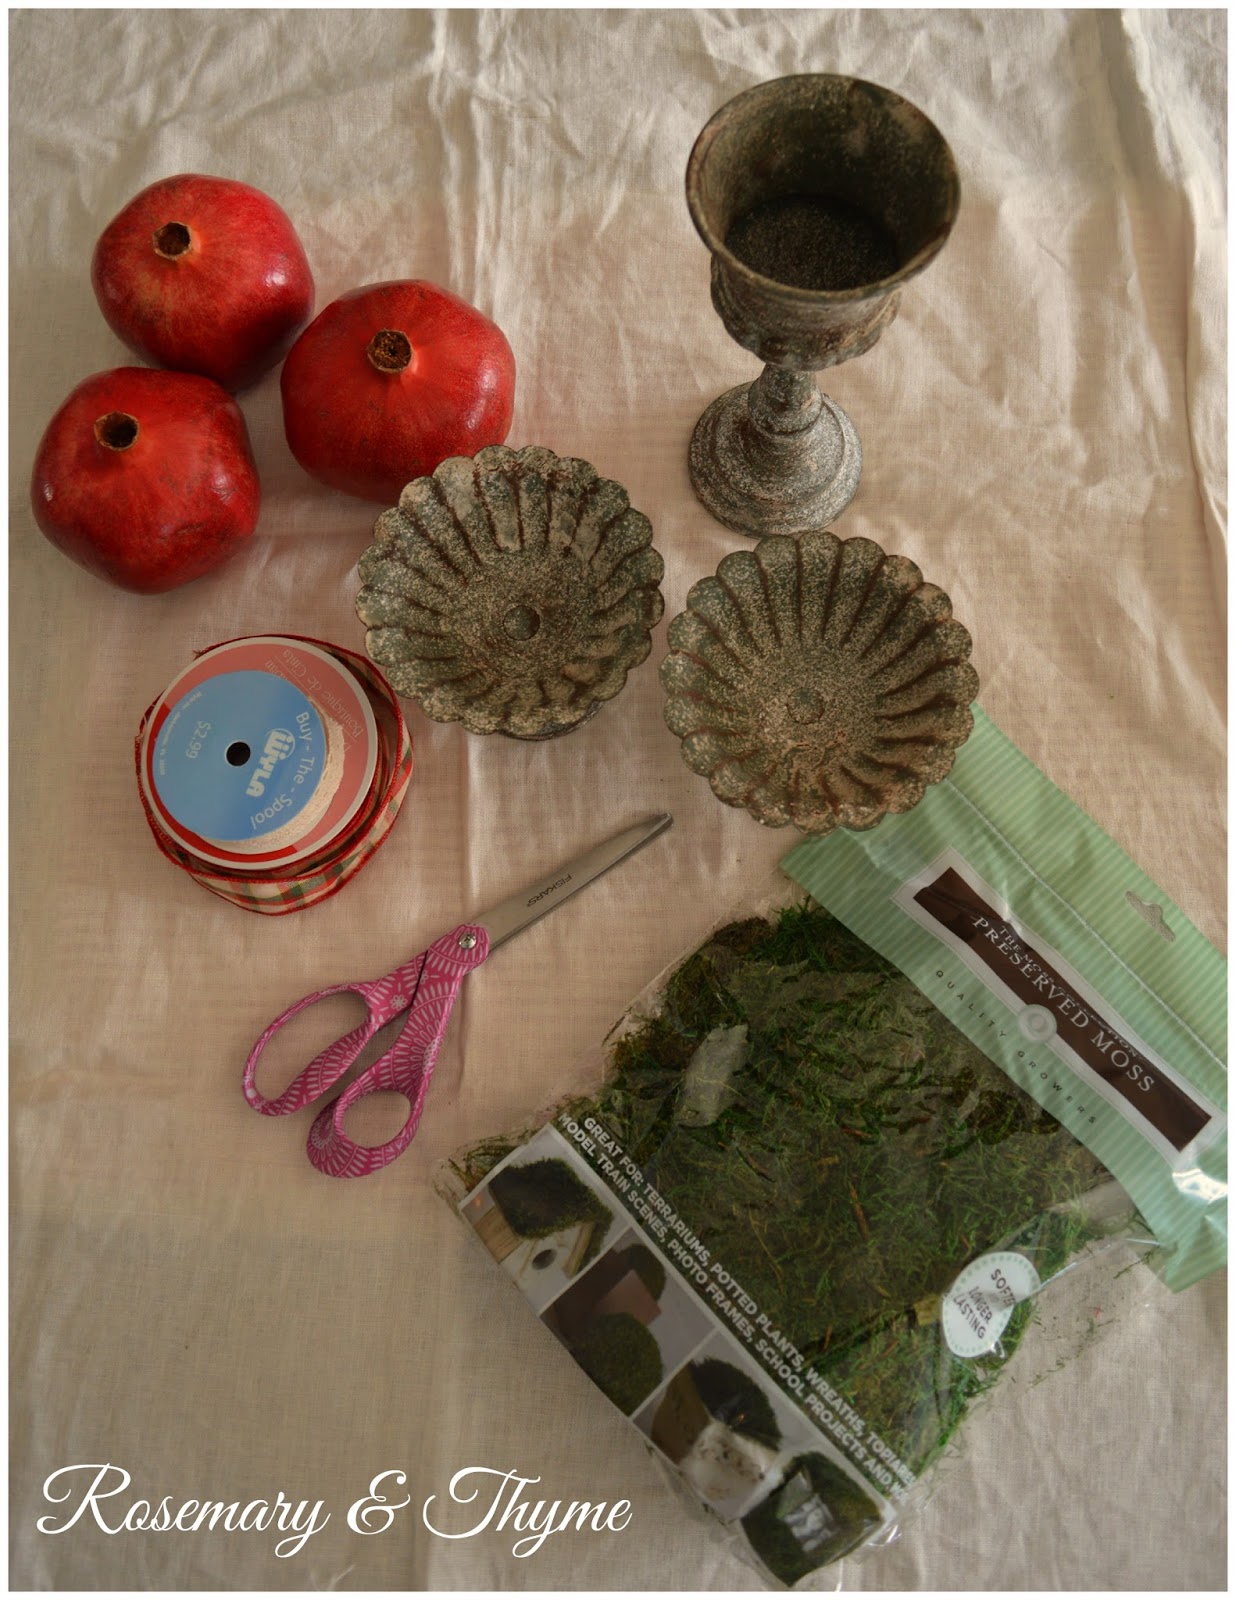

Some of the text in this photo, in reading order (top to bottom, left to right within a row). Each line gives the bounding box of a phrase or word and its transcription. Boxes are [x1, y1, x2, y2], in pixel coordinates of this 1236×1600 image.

[307, 677, 321, 691] de
[186, 720, 211, 759] $2.99
[296, 712, 312, 740] Buy
[293, 755, 315, 784] The
[250, 795, 292, 830] Spool
[528, 874, 572, 906] FISKARS
[999, 926, 1023, 953] THE
[972, 916, 1154, 1092] PRESERVED MOSS
[936, 970, 1096, 1124] QUALITY GROWERS
[583, 1117, 623, 1163] GREAT
[620, 1155, 646, 1187] FOR:
[644, 1184, 711, 1267] TERRARIUMS,
[710, 1262, 758, 1319] POTTED
[756, 1313, 806, 1372] PLANTS,
[806, 1368, 865, 1437] WREATHS,
[559, 1114, 596, 1157] MODEL
[597, 1153, 631, 1194] TRAIN
[627, 1190, 668, 1243] SCENES,
[667, 1238, 707, 1288] PHOTO
[706, 1284, 754, 1343] FRAMES,
[755, 1338, 806, 1396] SCHOOL
[805, 1392, 868, 1460] PROJECTS
[863, 1459, 893, 1486] AND
[953, 1294, 987, 1339] LASTING
